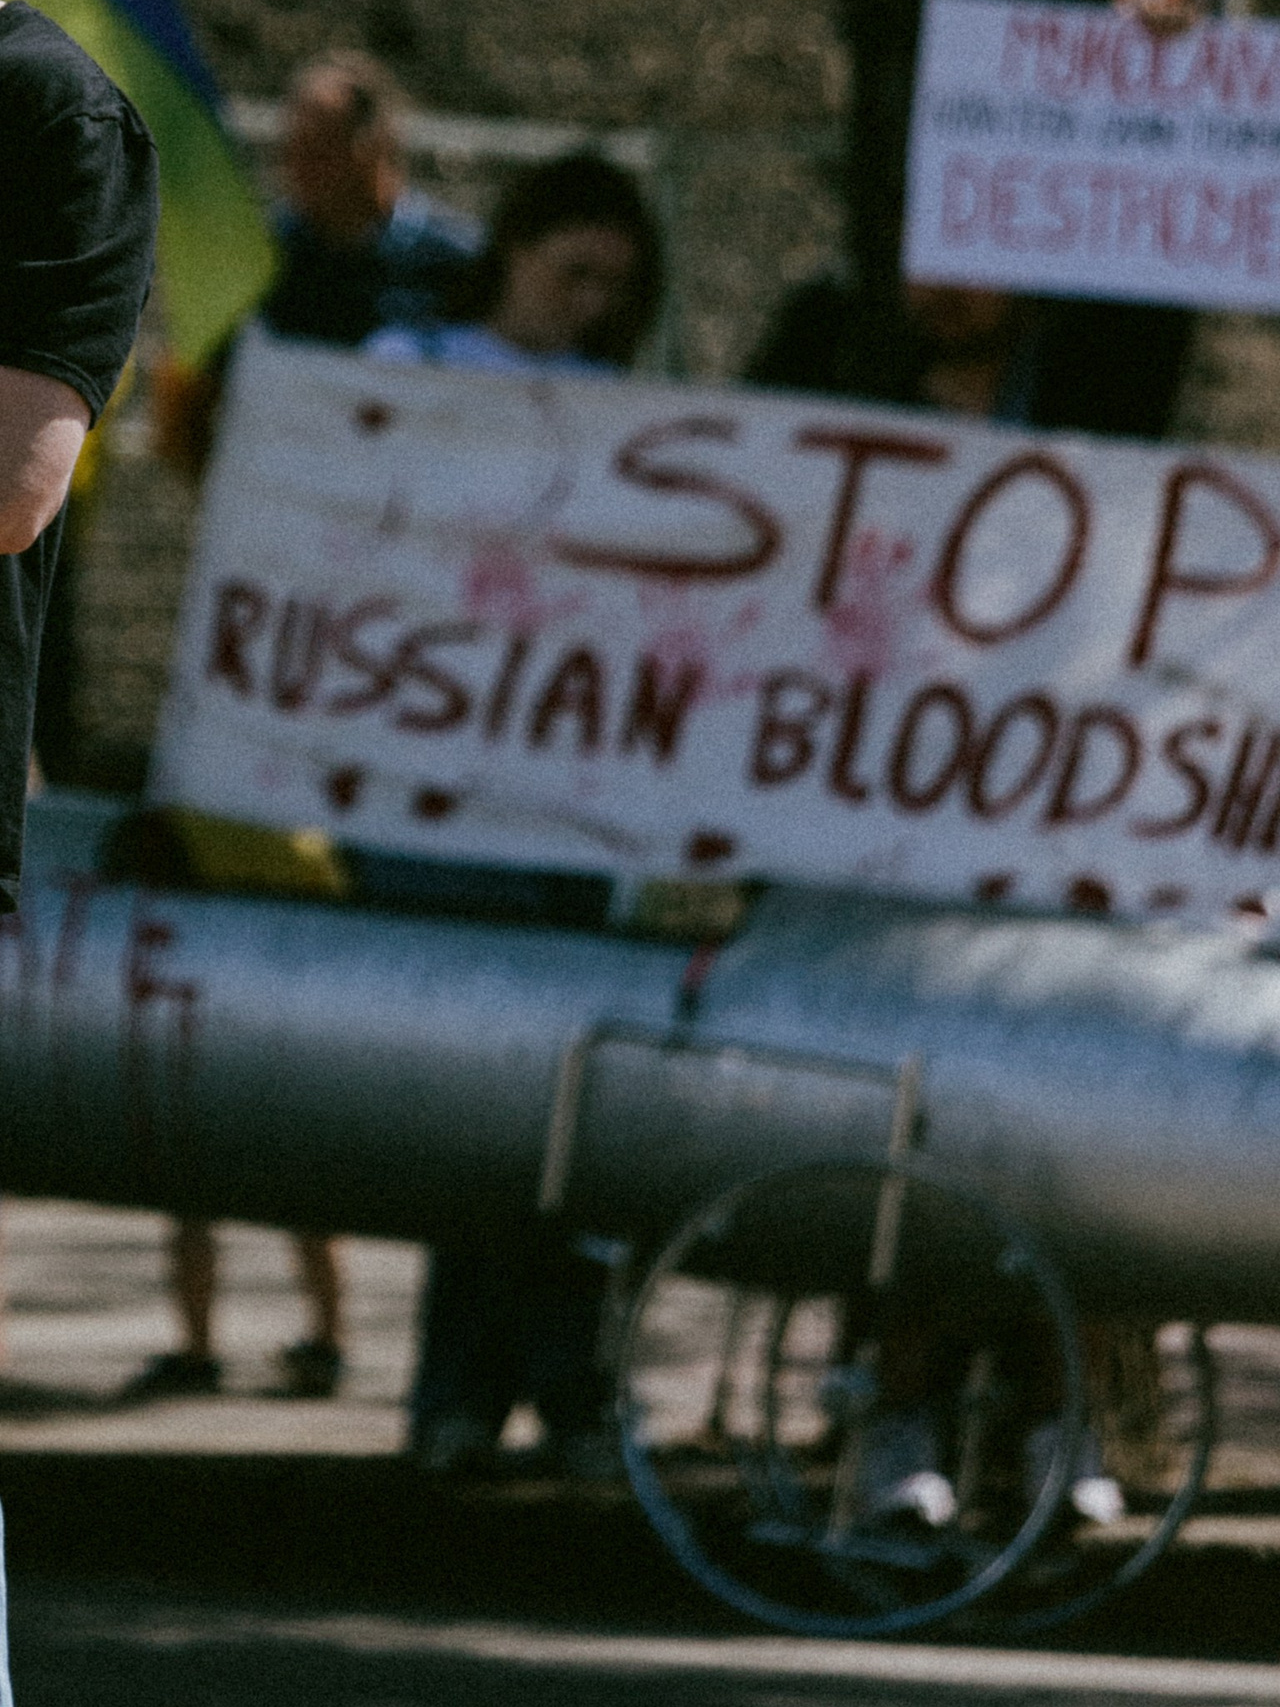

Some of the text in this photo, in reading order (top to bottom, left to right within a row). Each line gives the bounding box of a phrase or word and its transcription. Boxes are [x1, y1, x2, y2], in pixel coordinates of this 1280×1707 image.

[550, 414, 1280, 670] STOP
[208, 579, 1280, 856] RUSSIAN BLOODSH
